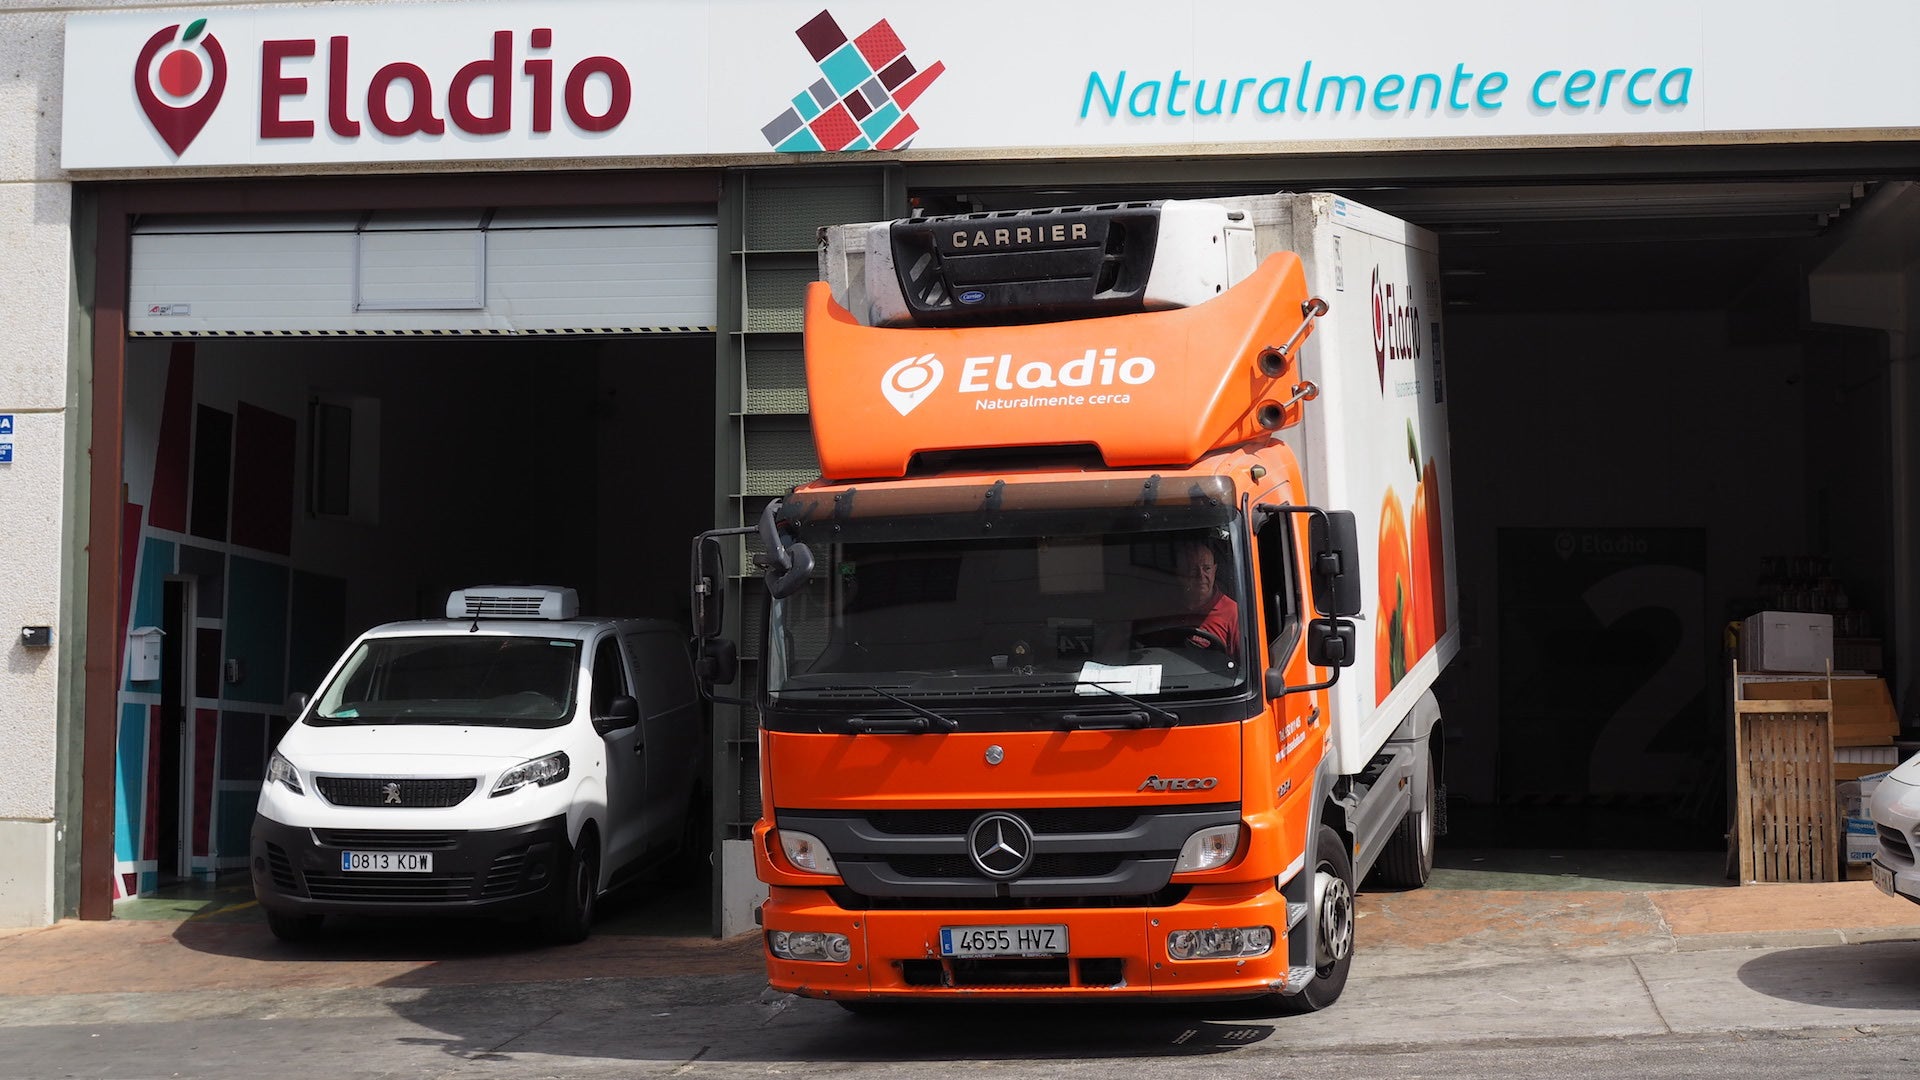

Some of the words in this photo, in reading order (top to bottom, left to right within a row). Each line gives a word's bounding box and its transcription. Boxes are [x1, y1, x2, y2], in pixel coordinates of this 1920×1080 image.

[261, 28, 631, 139] Eladio
[1080, 60, 1508, 118] Naturalmente
[1532, 67, 1694, 108] cerca
[952, 223, 1088, 248] CARRIER
[1386, 283, 1421, 360] Eladio
[958, 348, 1155, 393] Eladio
[975, 393, 1085, 411] Naturalmente
[1088, 393, 1131, 406] cerca
[352, 854, 389, 869] 0813
[398, 855, 428, 870] KDW
[961, 930, 1010, 950] 4655
[1018, 929, 1056, 949] HVZ
